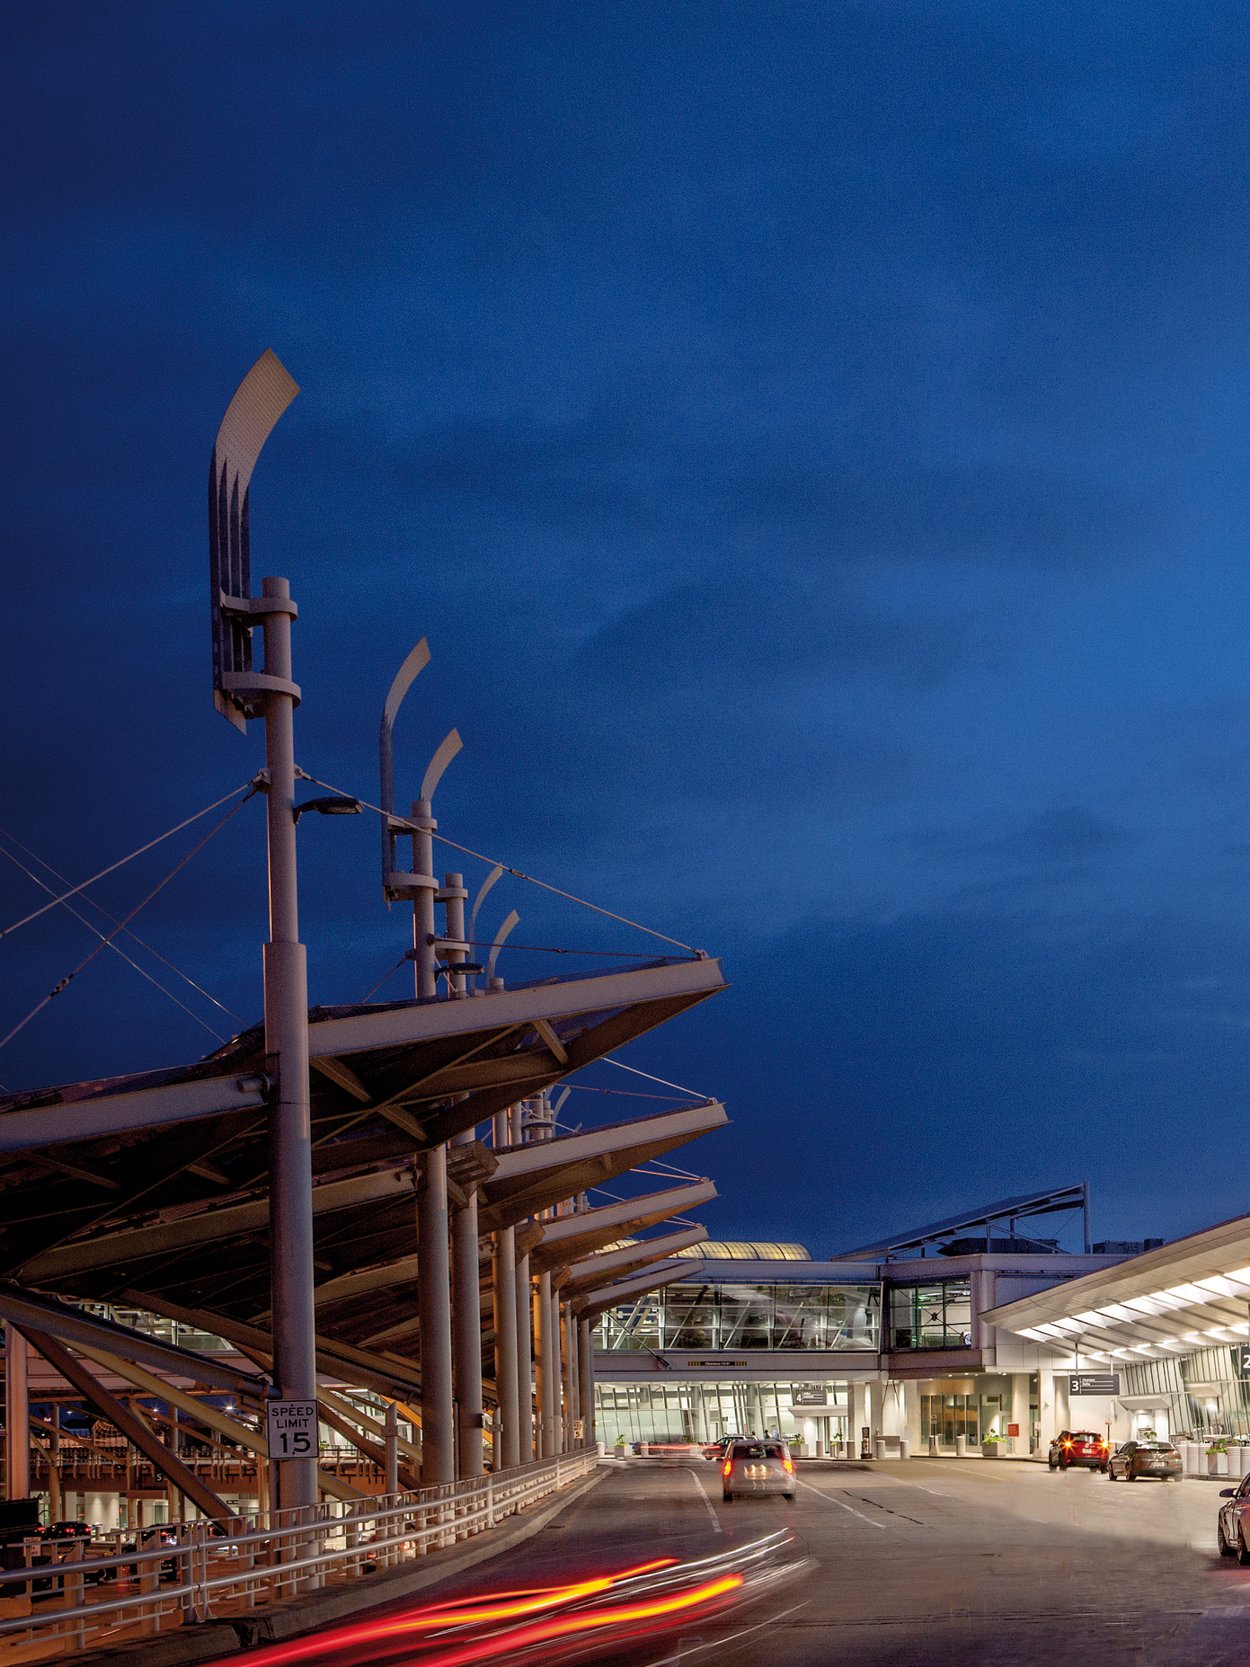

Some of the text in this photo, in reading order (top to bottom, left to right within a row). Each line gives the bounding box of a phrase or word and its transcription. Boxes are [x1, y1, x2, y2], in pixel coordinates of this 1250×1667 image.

[1071, 1380, 1080, 1392] 3
[796, 1393, 802, 1403] 4
[271, 1407, 314, 1417] SPEED
[276, 1419, 309, 1429] LIMIT
[280, 1432, 311, 1453] 15
